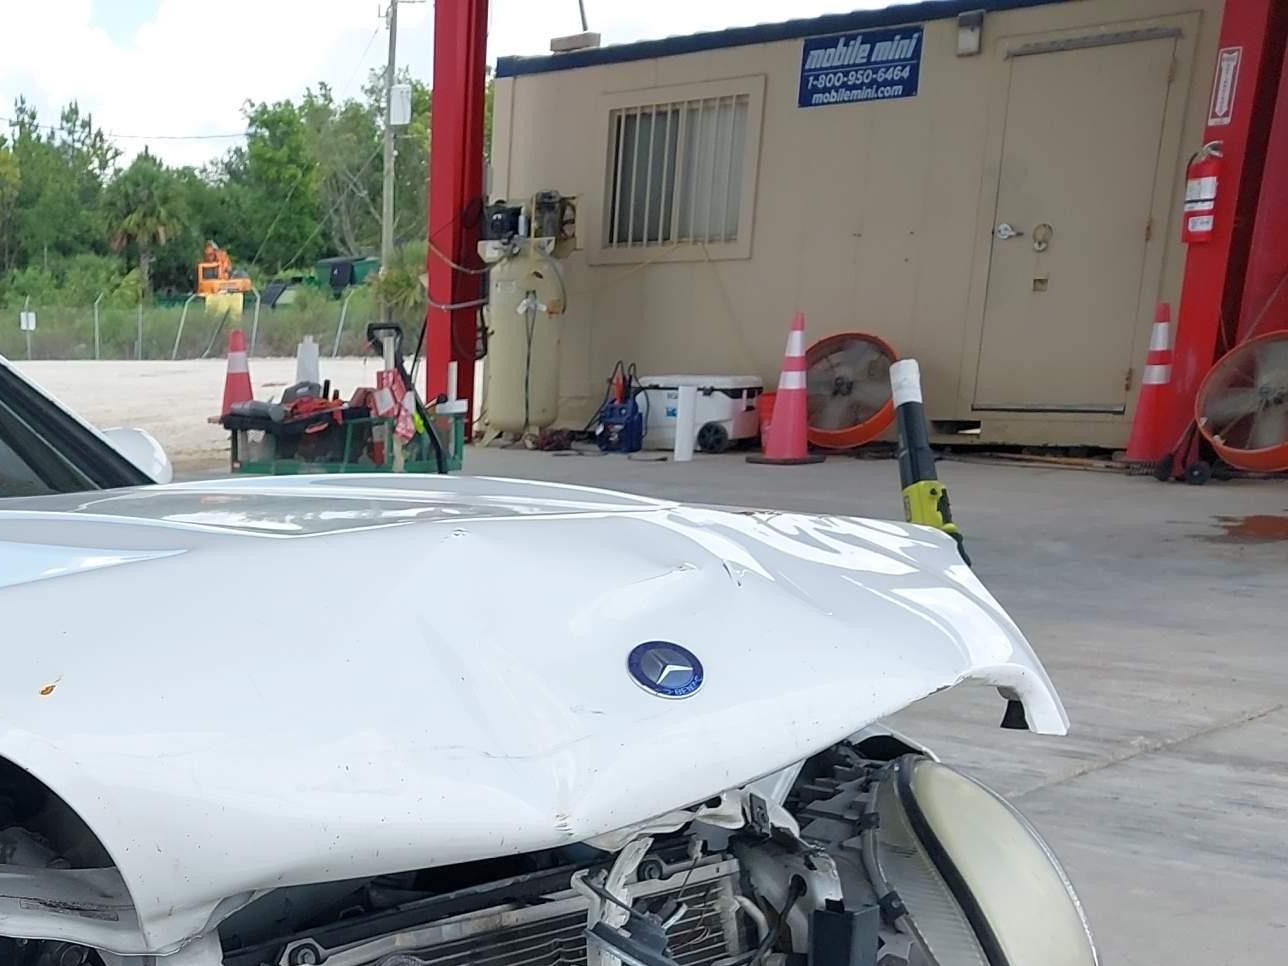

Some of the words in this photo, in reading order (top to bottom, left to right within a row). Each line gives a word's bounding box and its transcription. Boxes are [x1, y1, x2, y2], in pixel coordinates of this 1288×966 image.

[804, 35, 871, 69] mobile
[871, 32, 920, 62] mini
[807, 65, 911, 90] 1-800-950-6464
[812, 85, 904, 104] mobilemini.com
